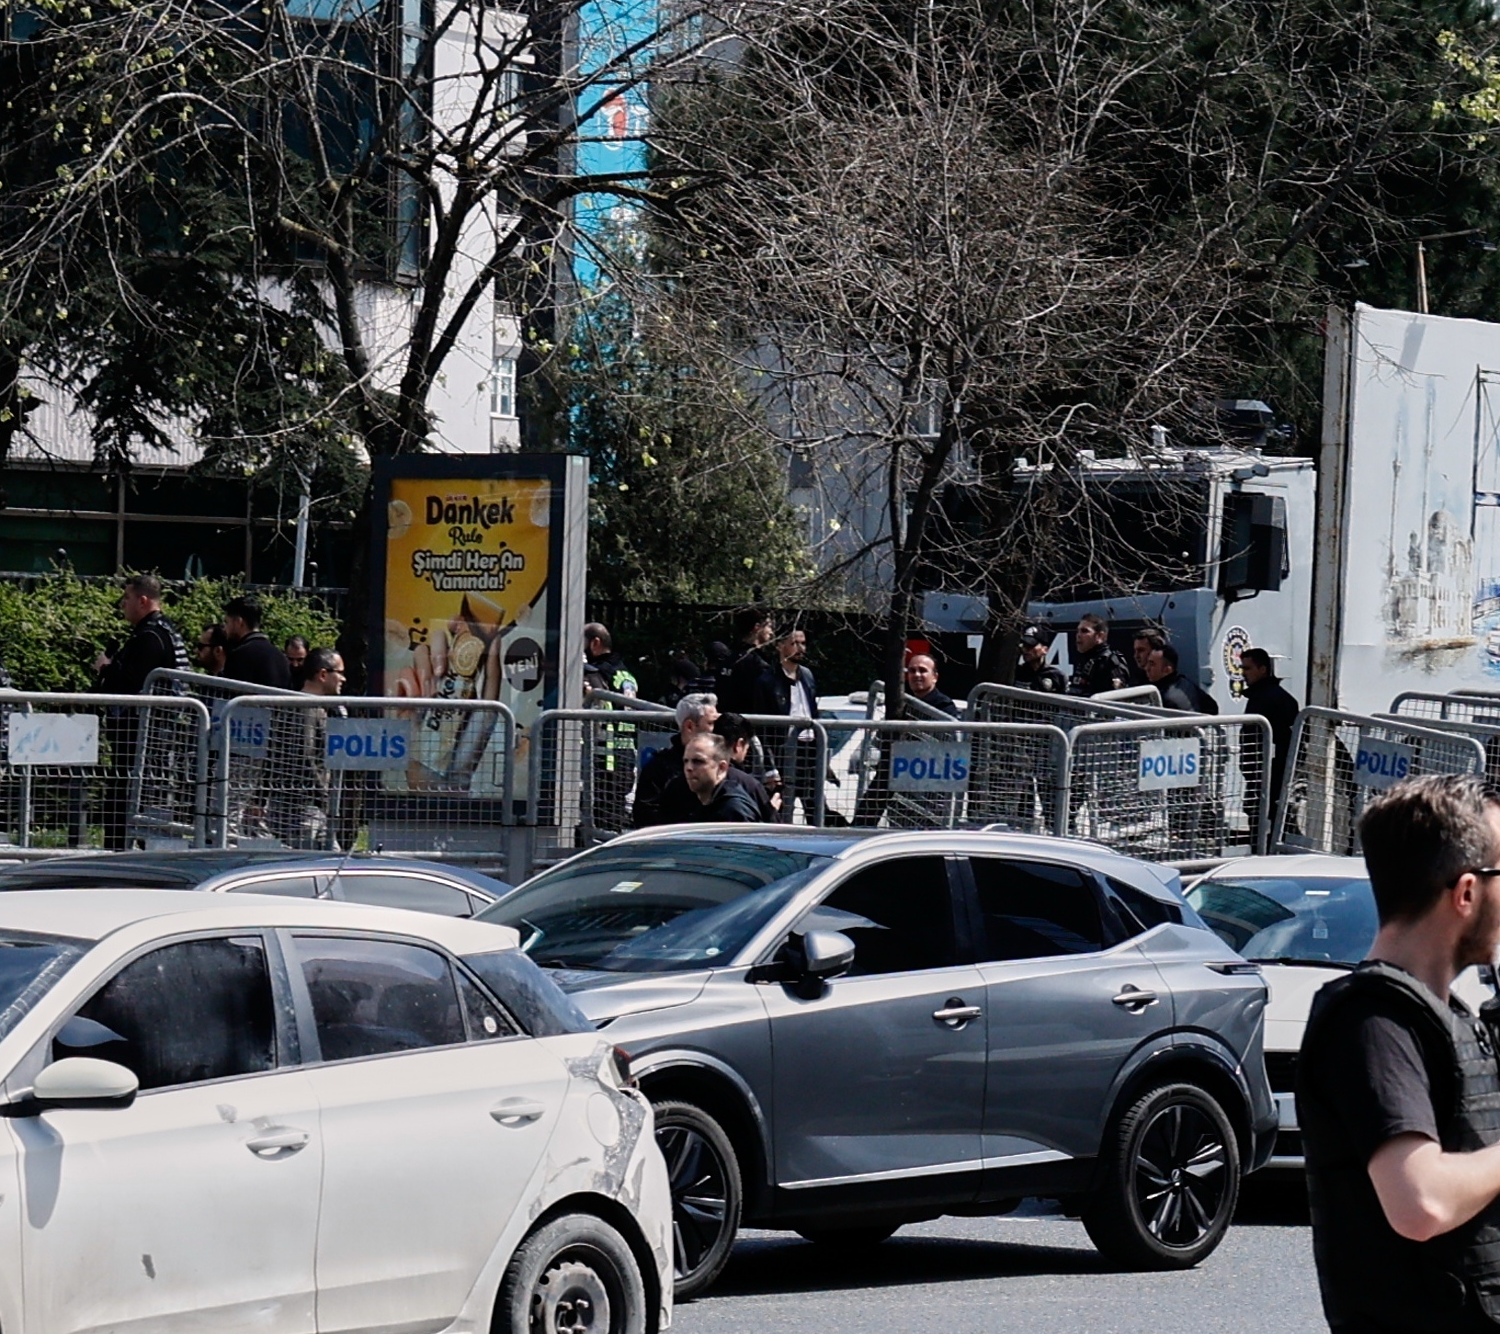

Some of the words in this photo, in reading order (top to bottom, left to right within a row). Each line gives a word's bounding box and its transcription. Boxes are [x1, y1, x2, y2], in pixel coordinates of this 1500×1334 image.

[426, 496, 516, 529] Dankek
[413, 550, 462, 576] Şimdi
[466, 550, 498, 571] Her
[501, 551, 524, 570] An
[431, 571, 504, 591] Yanında!
[508, 652, 539, 675] YENİ
[328, 729, 405, 759] POLİS
[892, 751, 967, 781] POLİS
[1142, 748, 1197, 778] POLİS
[1356, 749, 1408, 778] POLİS
